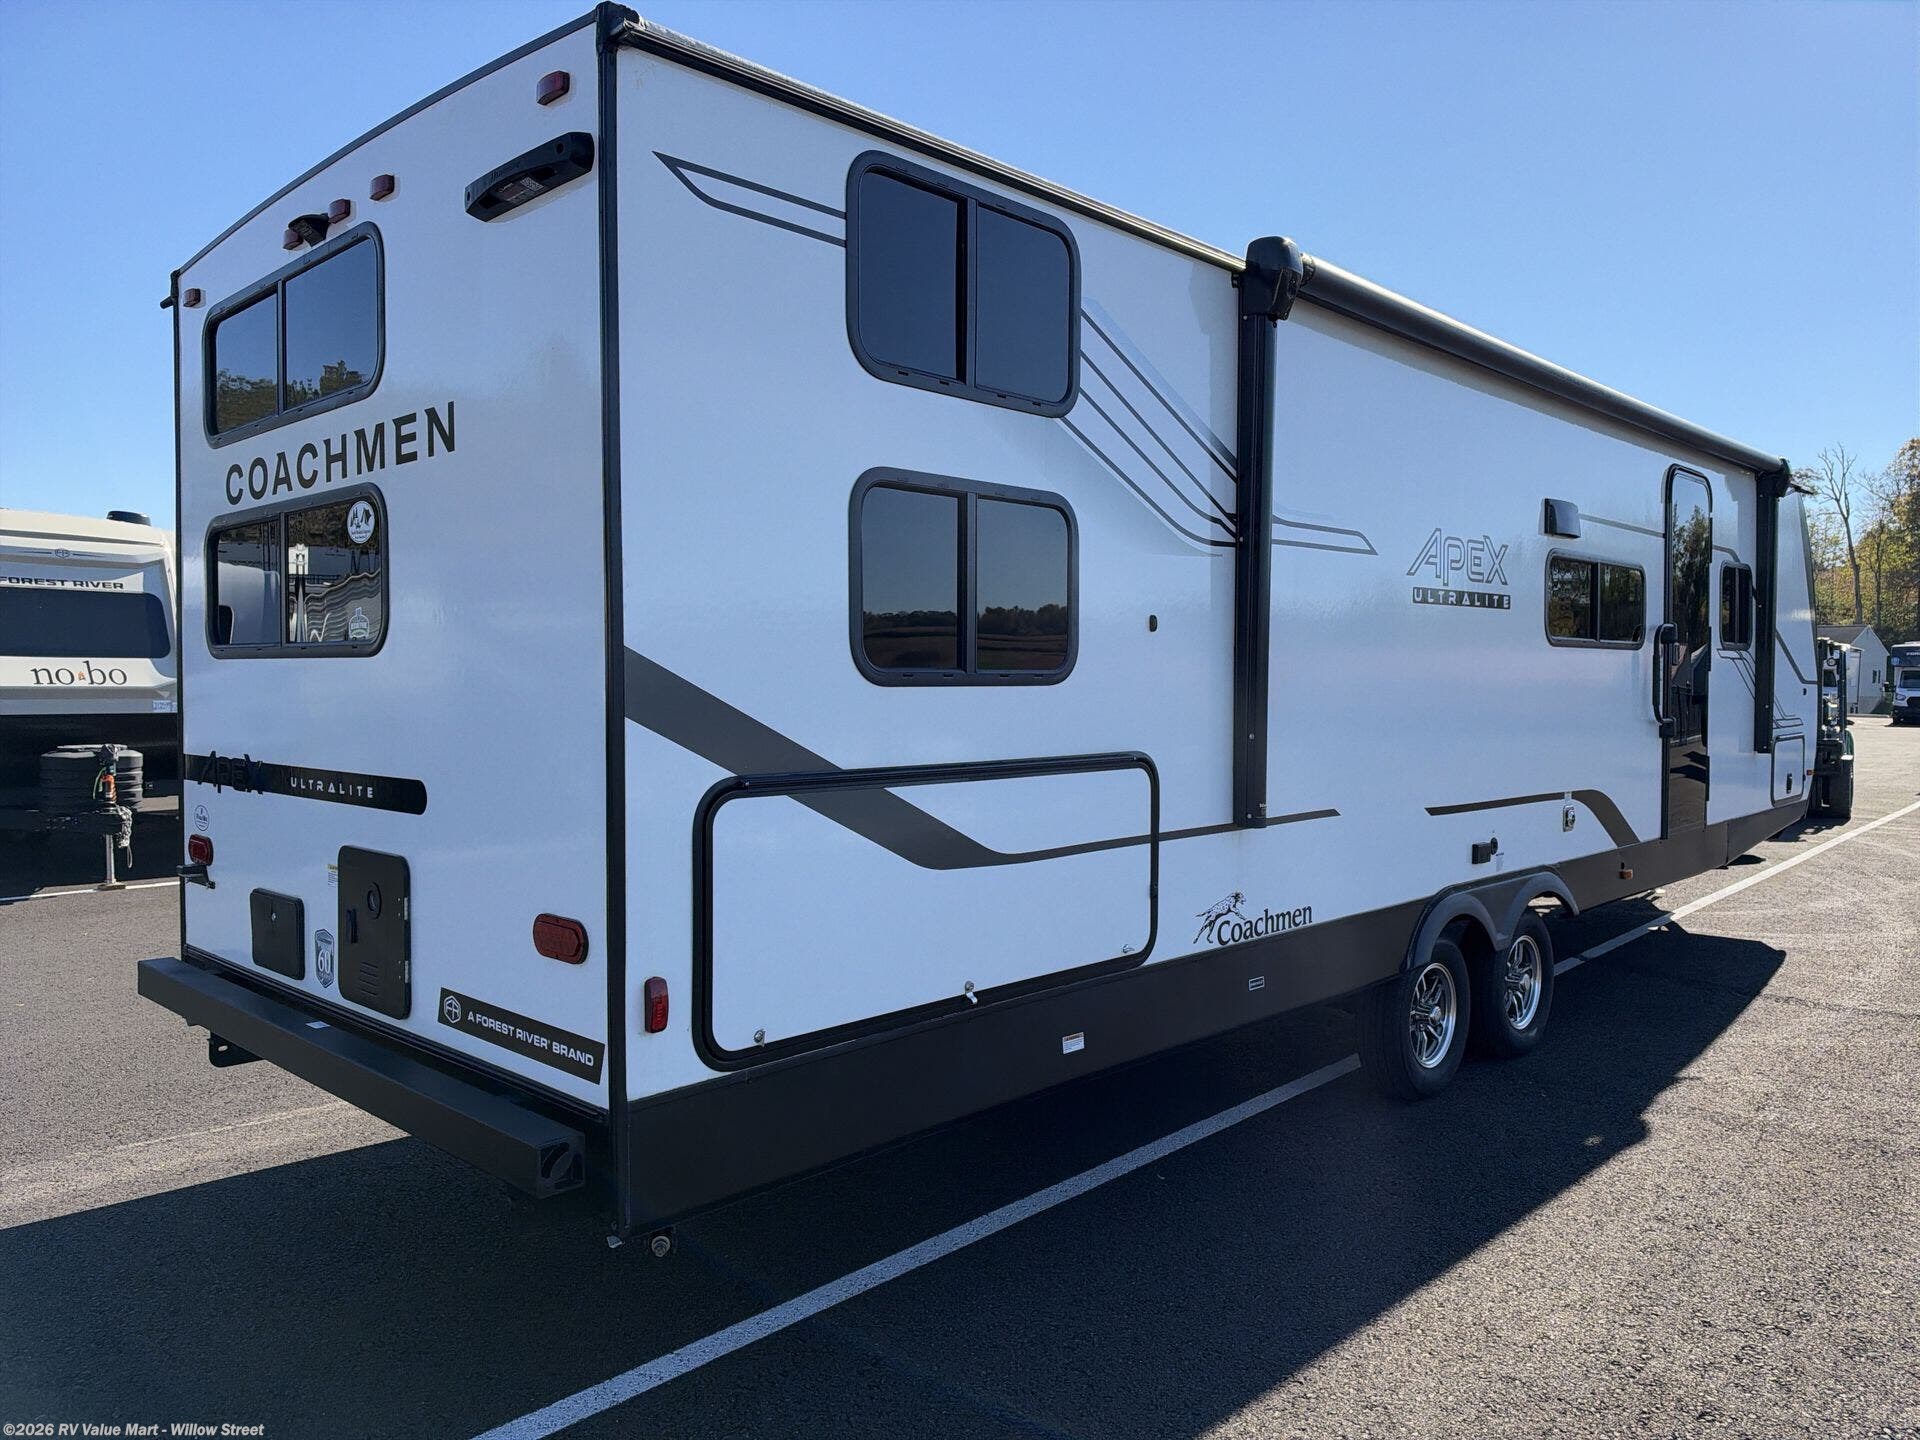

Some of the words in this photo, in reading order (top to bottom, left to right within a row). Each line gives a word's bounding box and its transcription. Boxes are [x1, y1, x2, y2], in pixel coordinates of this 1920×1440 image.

[225, 401, 455, 505] COACHMEN
[1406, 527, 1509, 586] APEX
[73, 580, 124, 589] RIVER
[1414, 588, 1509, 608] ULTRALITE
[290, 776, 374, 799] ULTRALITE
[1217, 905, 1313, 946] Coachmen
[318, 949, 331, 974] 60
[467, 1011, 475, 1022] A
[476, 1013, 515, 1037] FOREST
[552, 1041, 594, 1067] BRAND
